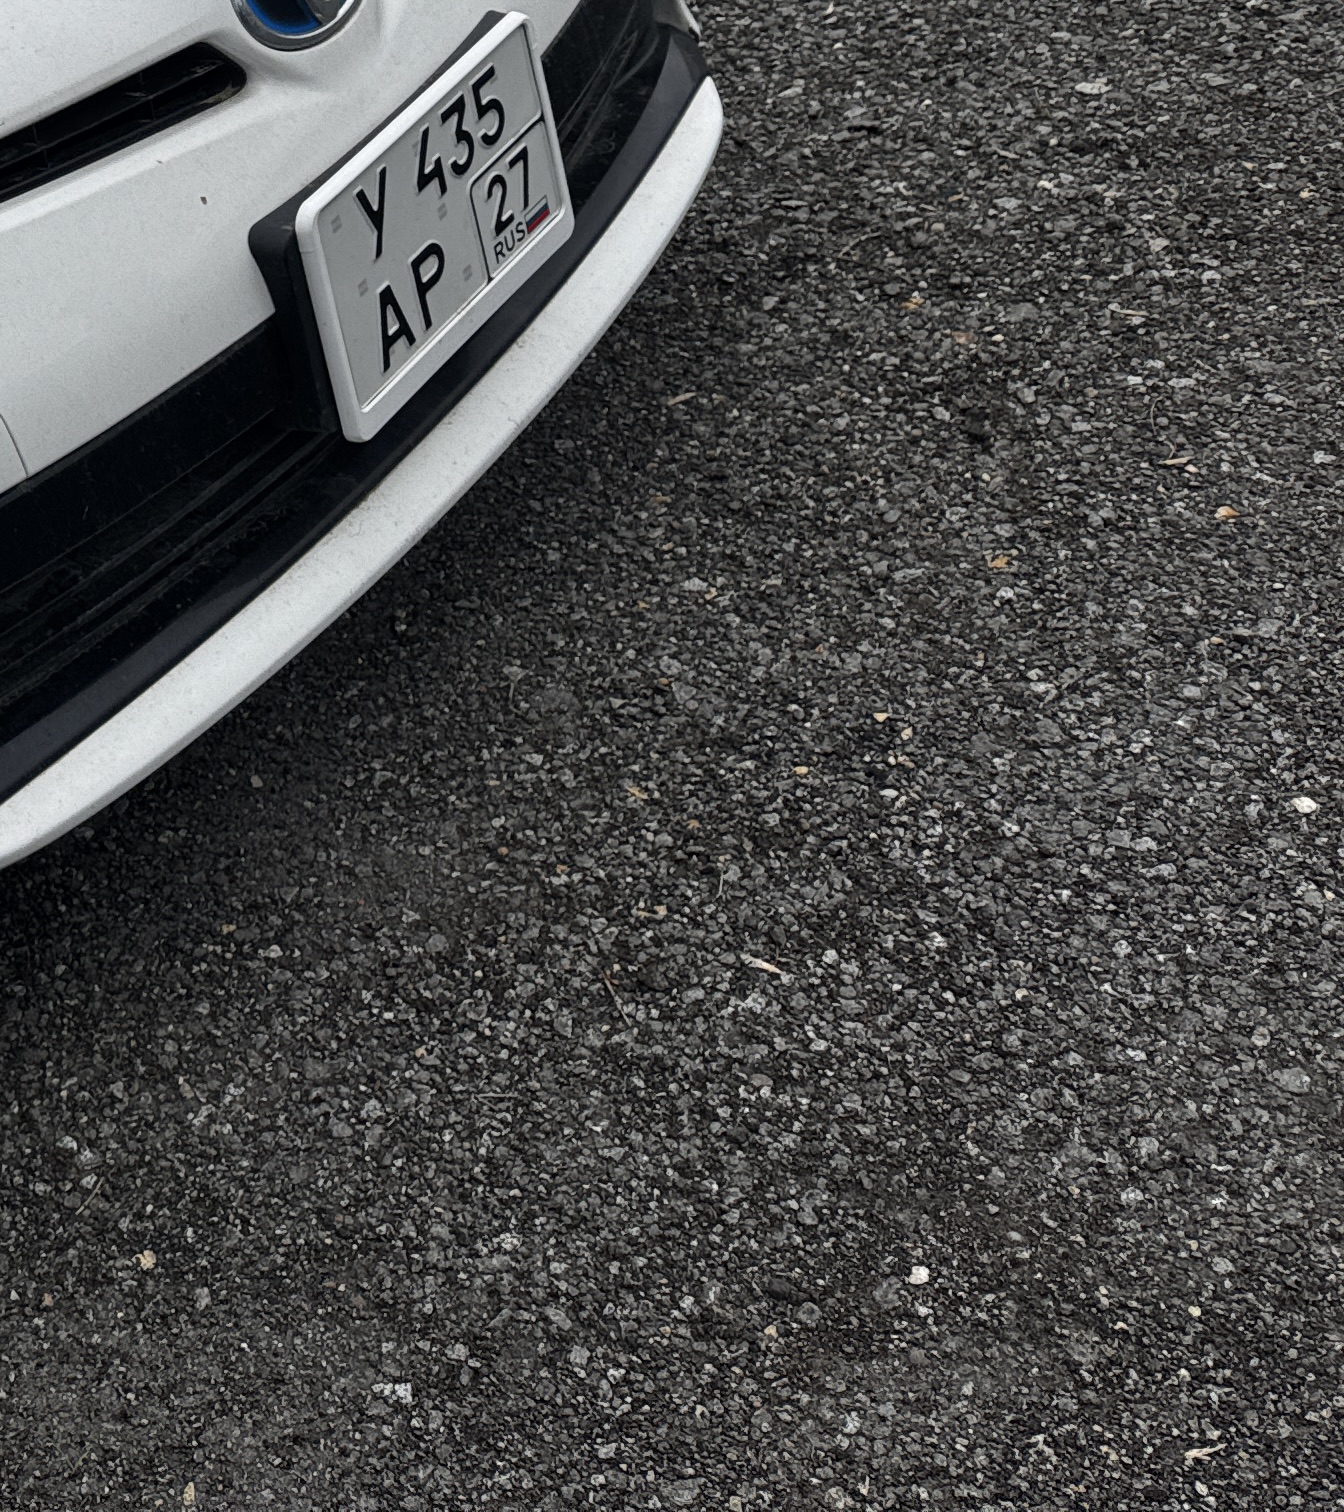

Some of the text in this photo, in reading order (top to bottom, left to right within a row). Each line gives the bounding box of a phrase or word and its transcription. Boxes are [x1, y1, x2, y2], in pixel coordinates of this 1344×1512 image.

[415, 63, 506, 200] 435
[377, 144, 531, 375] АР 27
[493, 221, 527, 265] RUS
